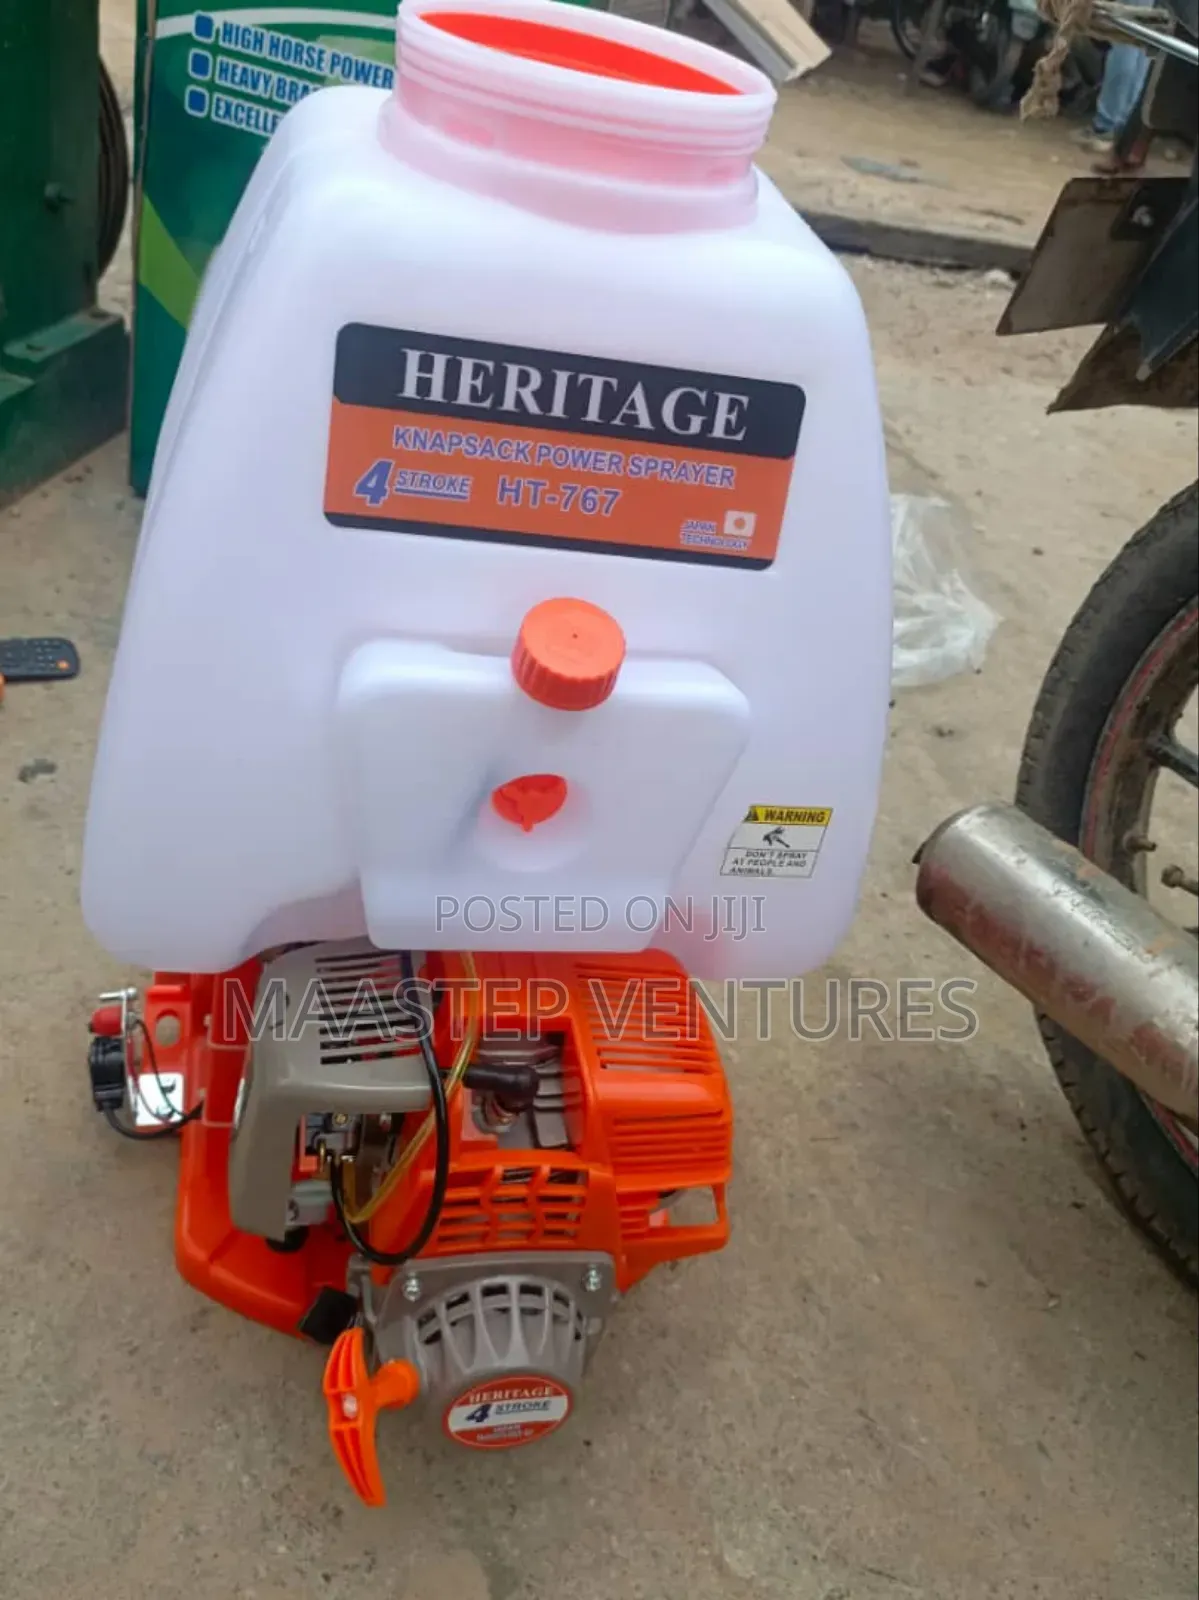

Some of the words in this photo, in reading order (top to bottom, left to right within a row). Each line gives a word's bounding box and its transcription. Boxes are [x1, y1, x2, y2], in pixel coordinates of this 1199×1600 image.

[220, 21, 265, 55] HIGH
[266, 30, 327, 75] HORSE
[328, 49, 395, 90] POWER
[215, 56, 273, 99] HEAVY
[273, 73, 322, 105] BRA
[396, 347, 750, 442] HERITAGE
[392, 424, 532, 466] KNAPSACK
[535, 443, 624, 477] POWER
[627, 454, 736, 490] SPRAYER
[353, 457, 395, 509] 4
[394, 469, 473, 502] STROKE
[496, 474, 623, 518] HT-767
[764, 807, 826, 823] WARNING
[747, 859, 784, 867] PEOPLE
[465, 1403, 492, 1422] 4
[495, 1400, 551, 1414] STROKE
[469, 1386, 553, 1403] HERITAGE
